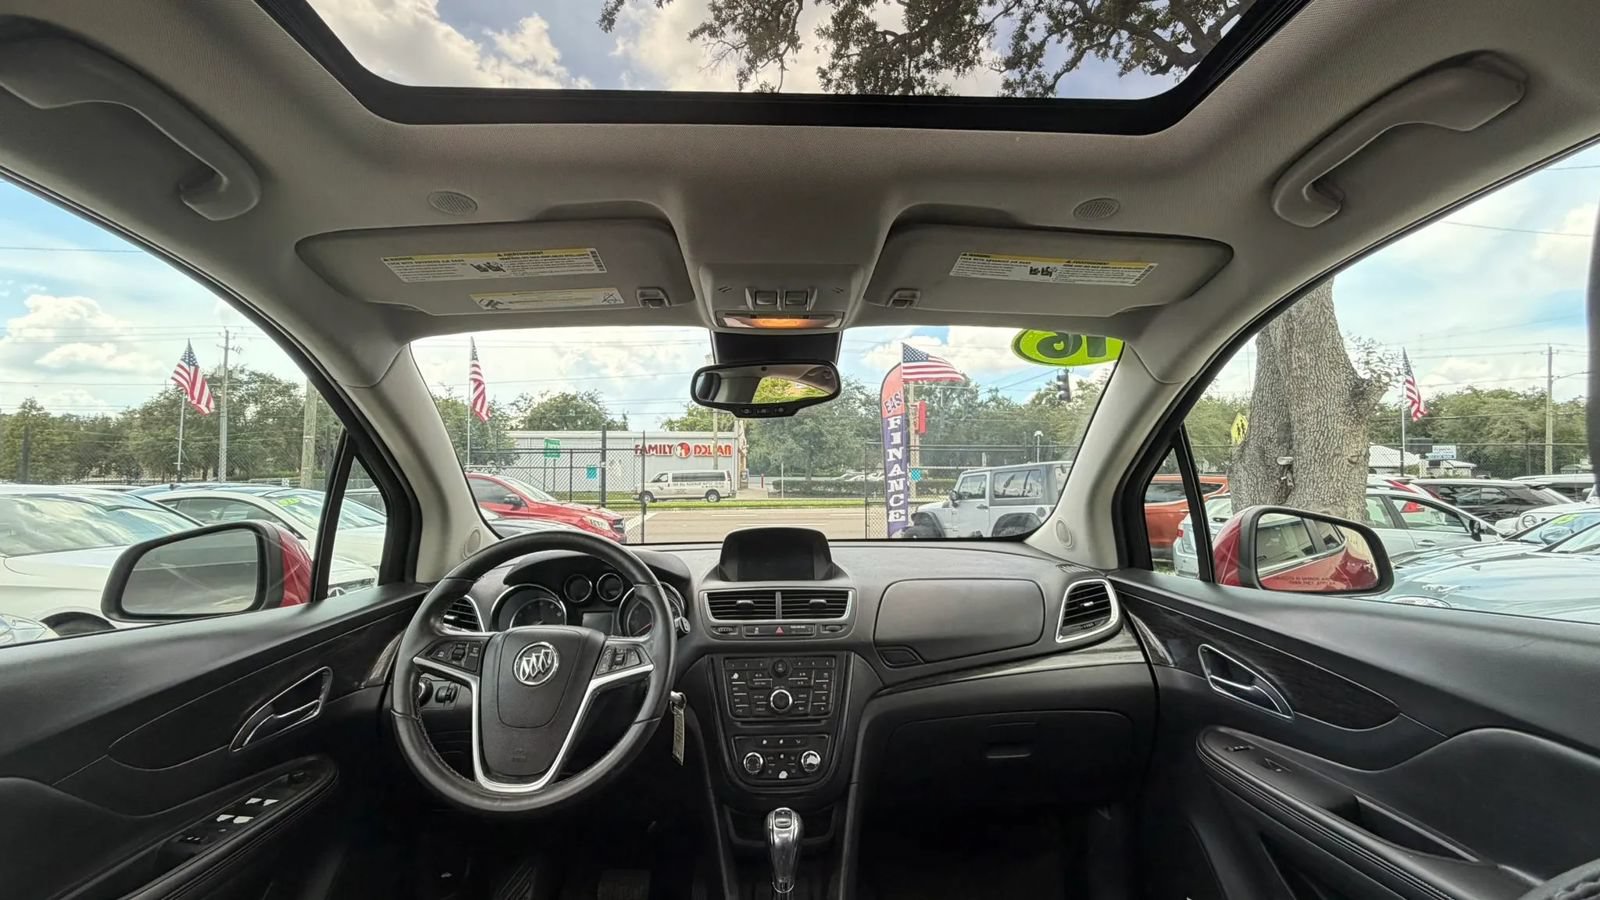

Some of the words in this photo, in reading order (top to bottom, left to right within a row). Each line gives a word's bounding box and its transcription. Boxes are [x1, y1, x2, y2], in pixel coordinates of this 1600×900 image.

[884, 390, 903, 414] EAS
[634, 444, 674, 455] FAMILY
[693, 444, 732, 455] DOLAR
[886, 416, 906, 522] FINANCE
